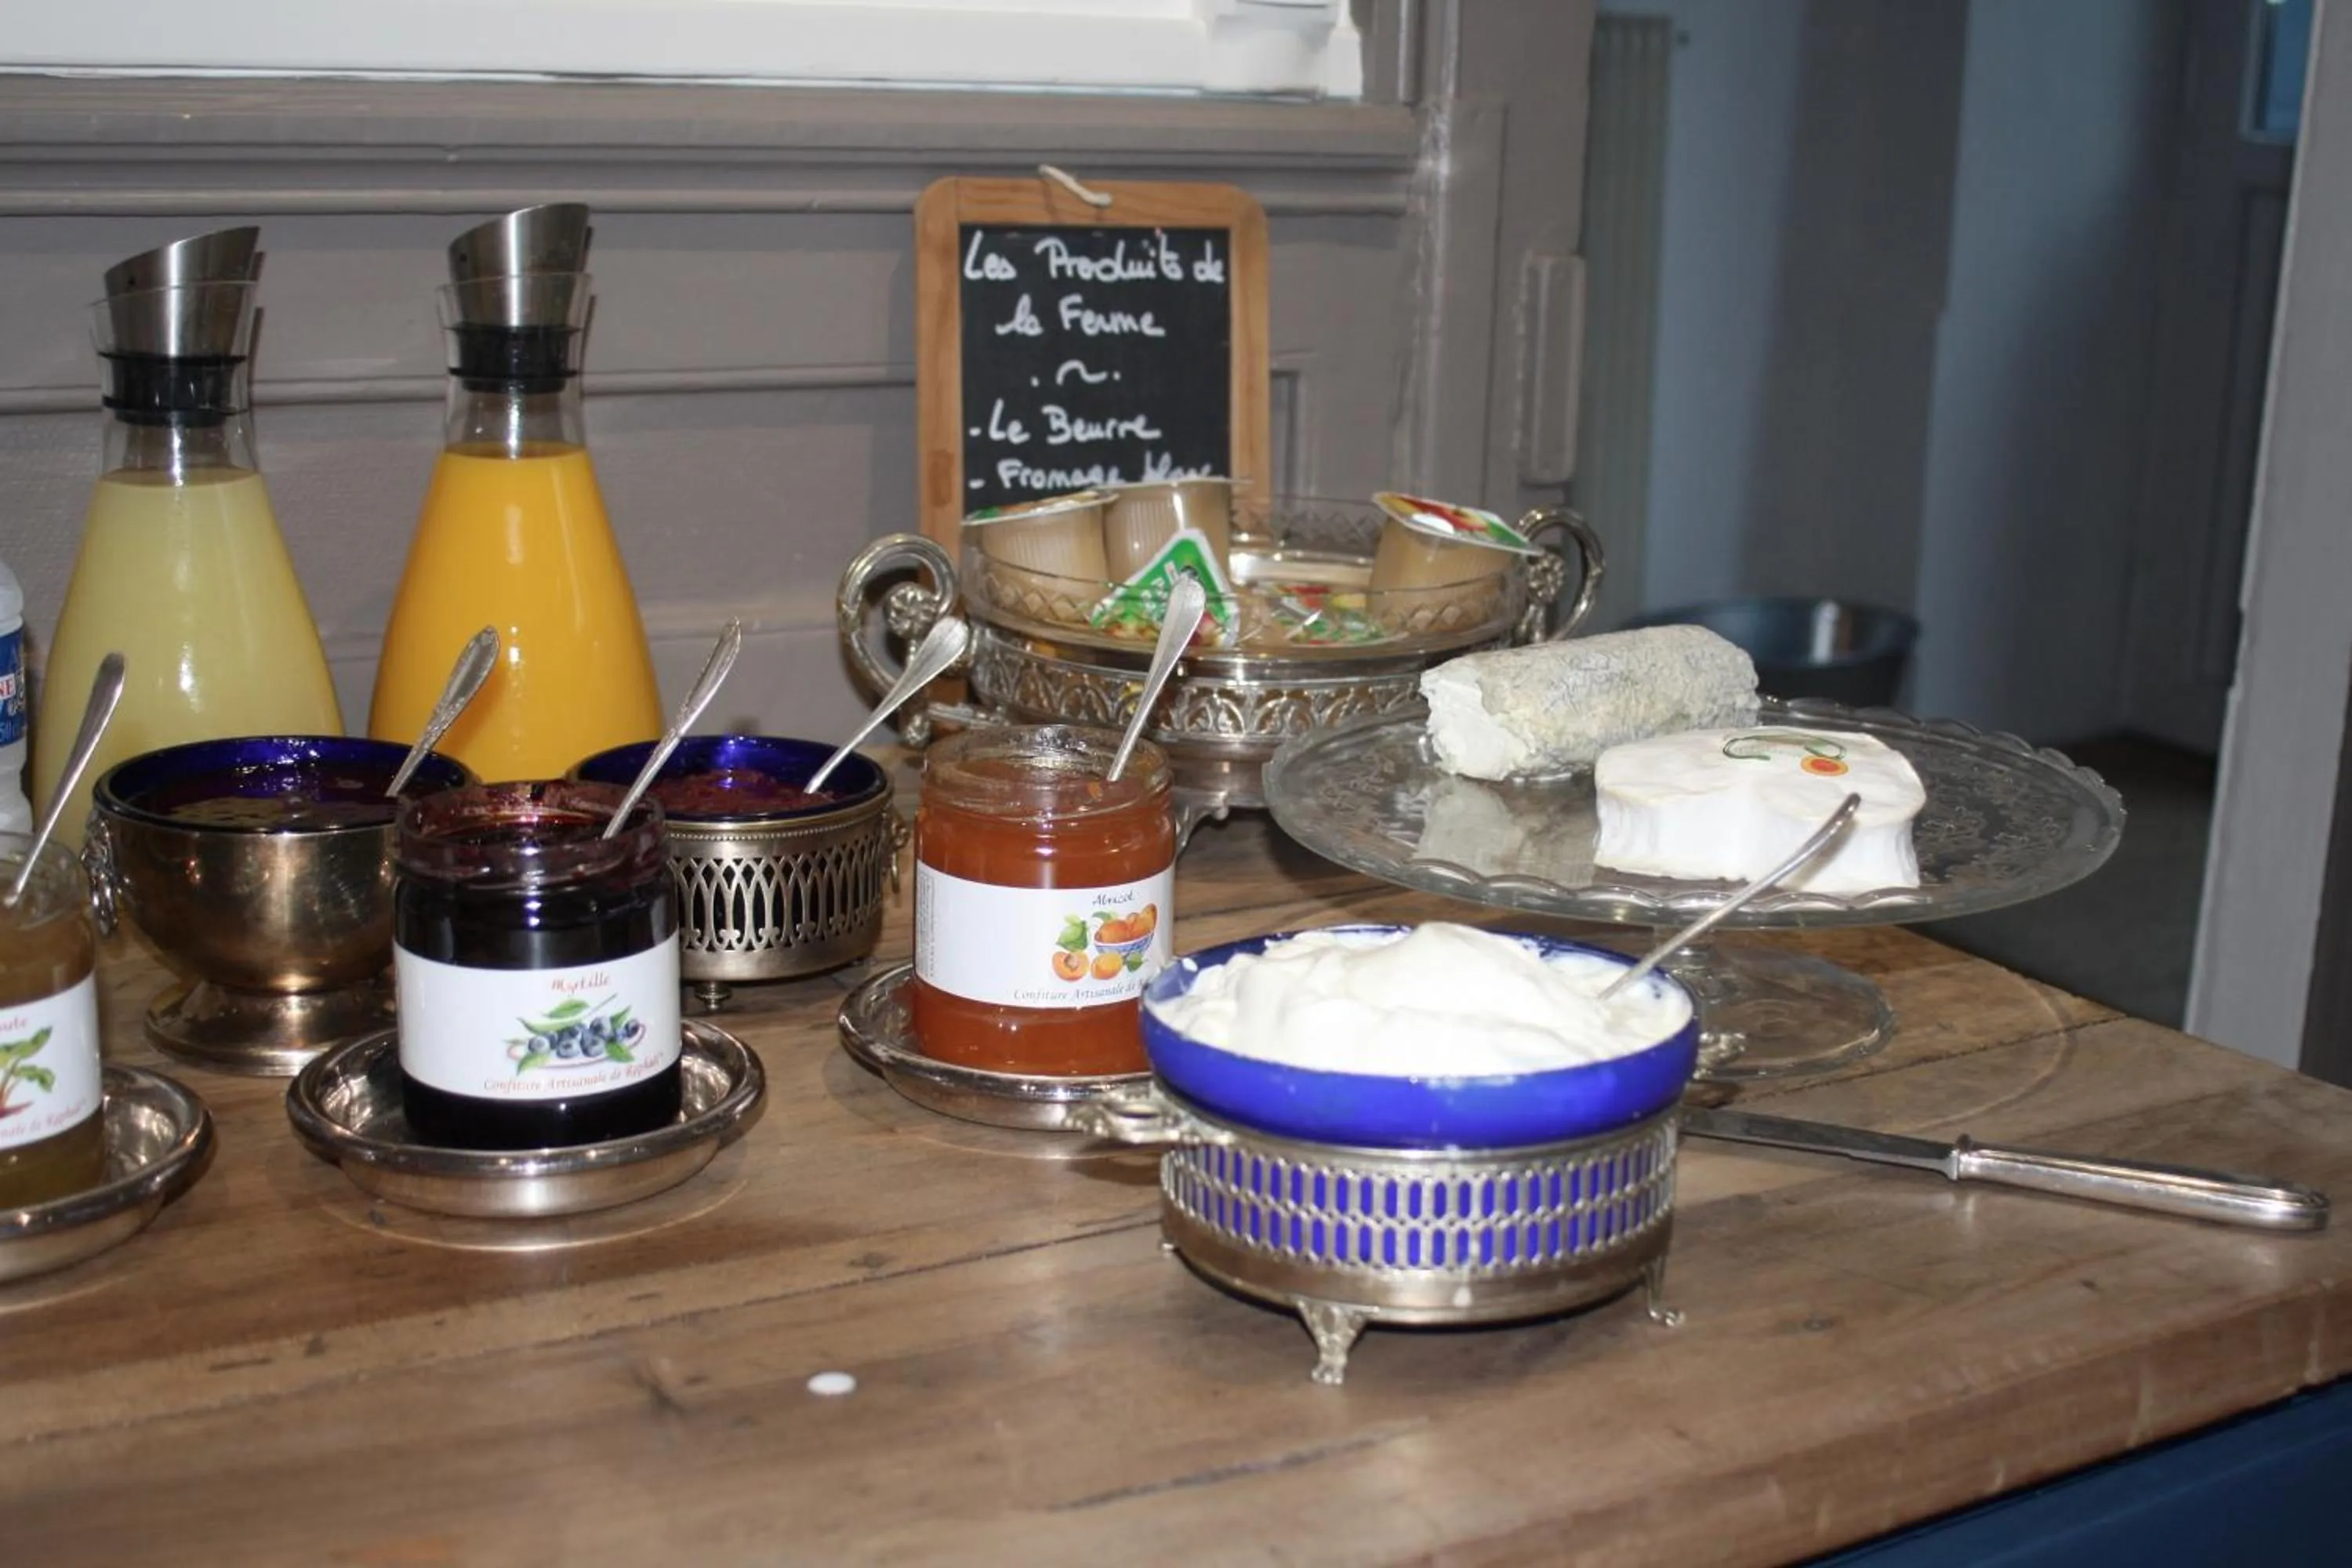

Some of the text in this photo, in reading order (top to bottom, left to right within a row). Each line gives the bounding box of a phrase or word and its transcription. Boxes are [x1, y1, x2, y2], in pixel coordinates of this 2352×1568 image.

[964, 230, 1225, 283] Les Produits de
[995, 293, 1167, 337] la Ferme
[1042, 405, 1162, 445] Beurre
